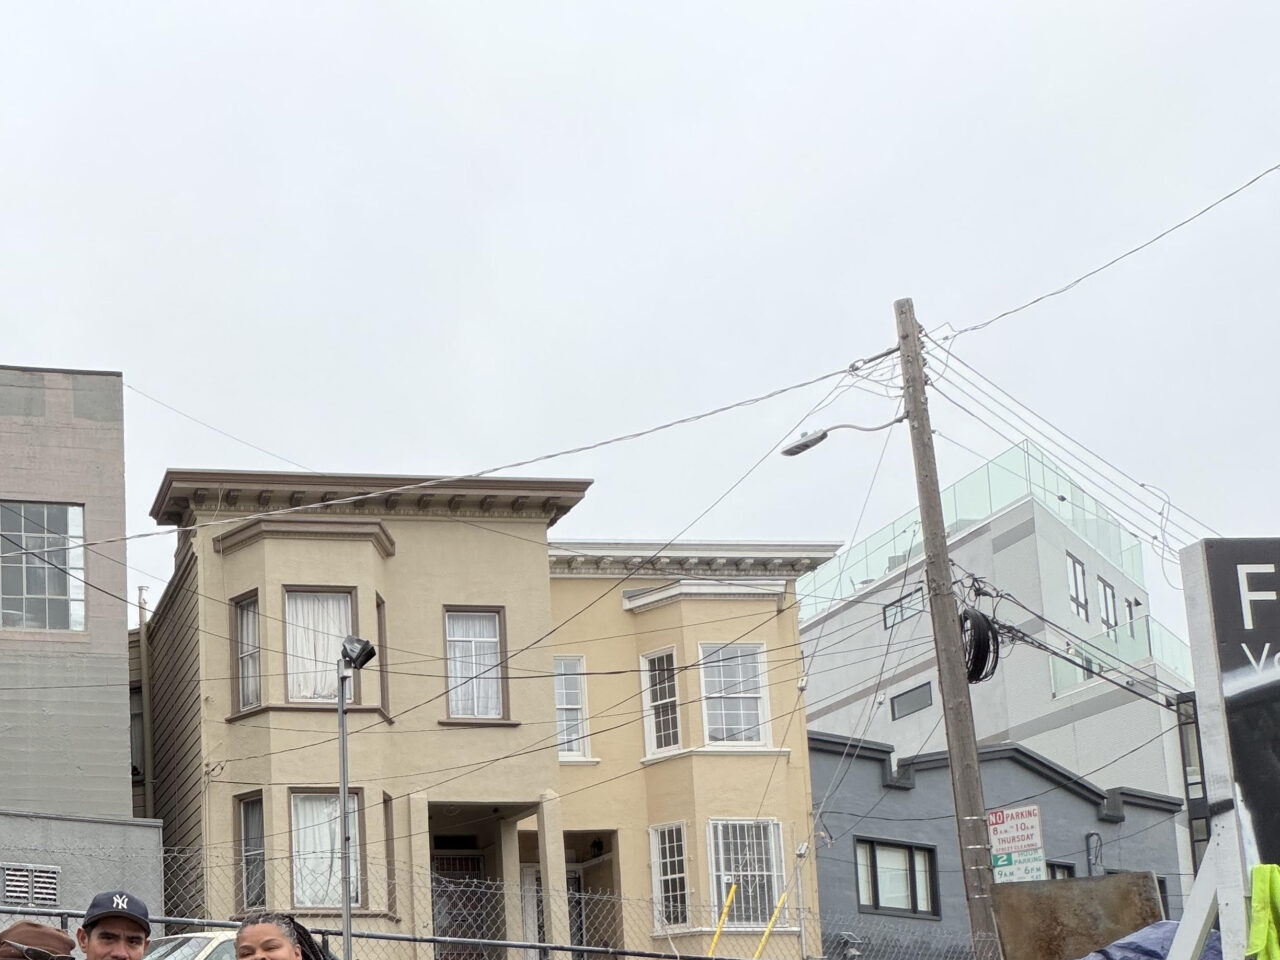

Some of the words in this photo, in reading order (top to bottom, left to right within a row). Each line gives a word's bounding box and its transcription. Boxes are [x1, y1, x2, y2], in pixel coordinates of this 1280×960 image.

[989, 811, 1004, 825] NO
[1006, 809, 1037, 821] PARKING
[997, 833, 1034, 846] THURSDAY
[997, 855, 1008, 865] 2
